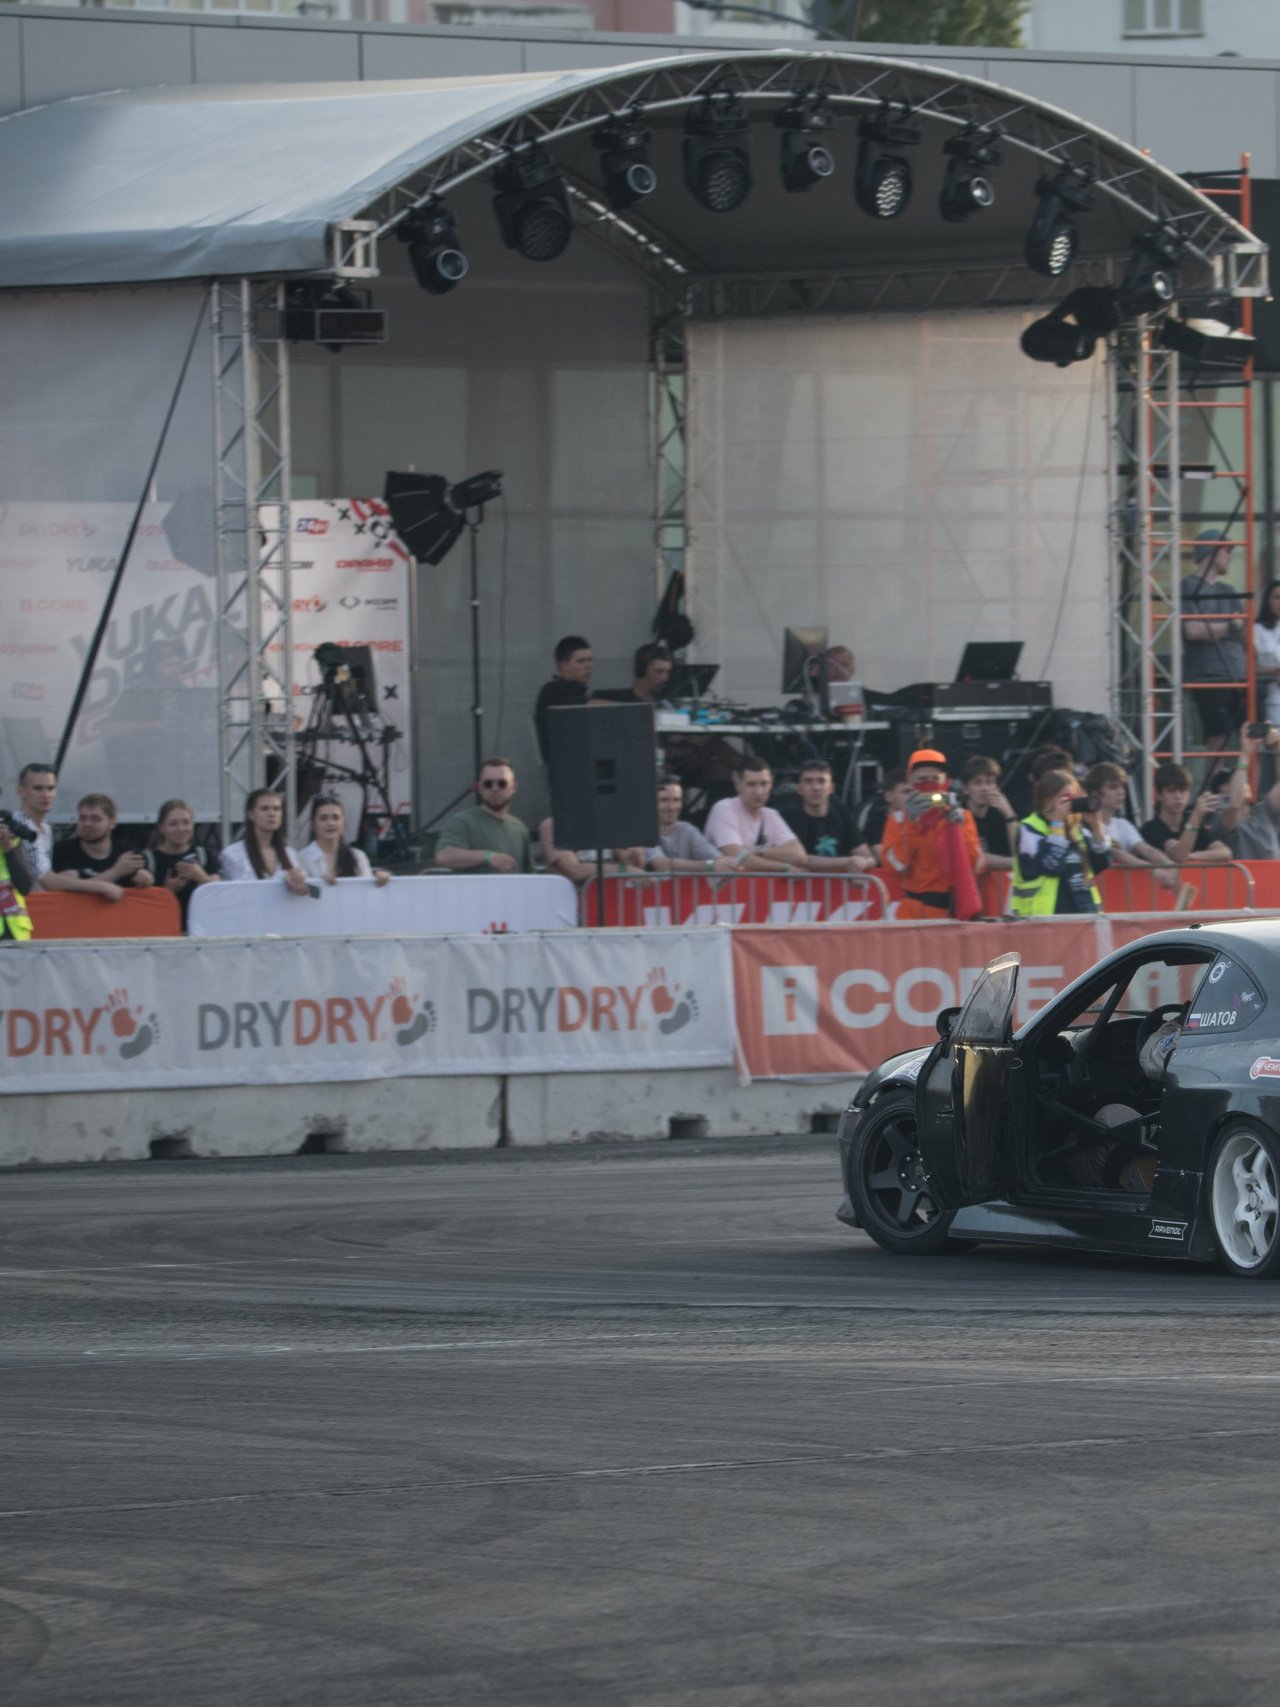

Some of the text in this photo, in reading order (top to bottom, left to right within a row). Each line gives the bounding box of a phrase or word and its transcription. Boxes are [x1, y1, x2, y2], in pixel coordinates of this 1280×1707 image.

[199, 997, 384, 1050] DRYDRY
[467, 986, 645, 1034] DRYDRY
[1199, 1010, 1238, 1028] ШАТОВ
